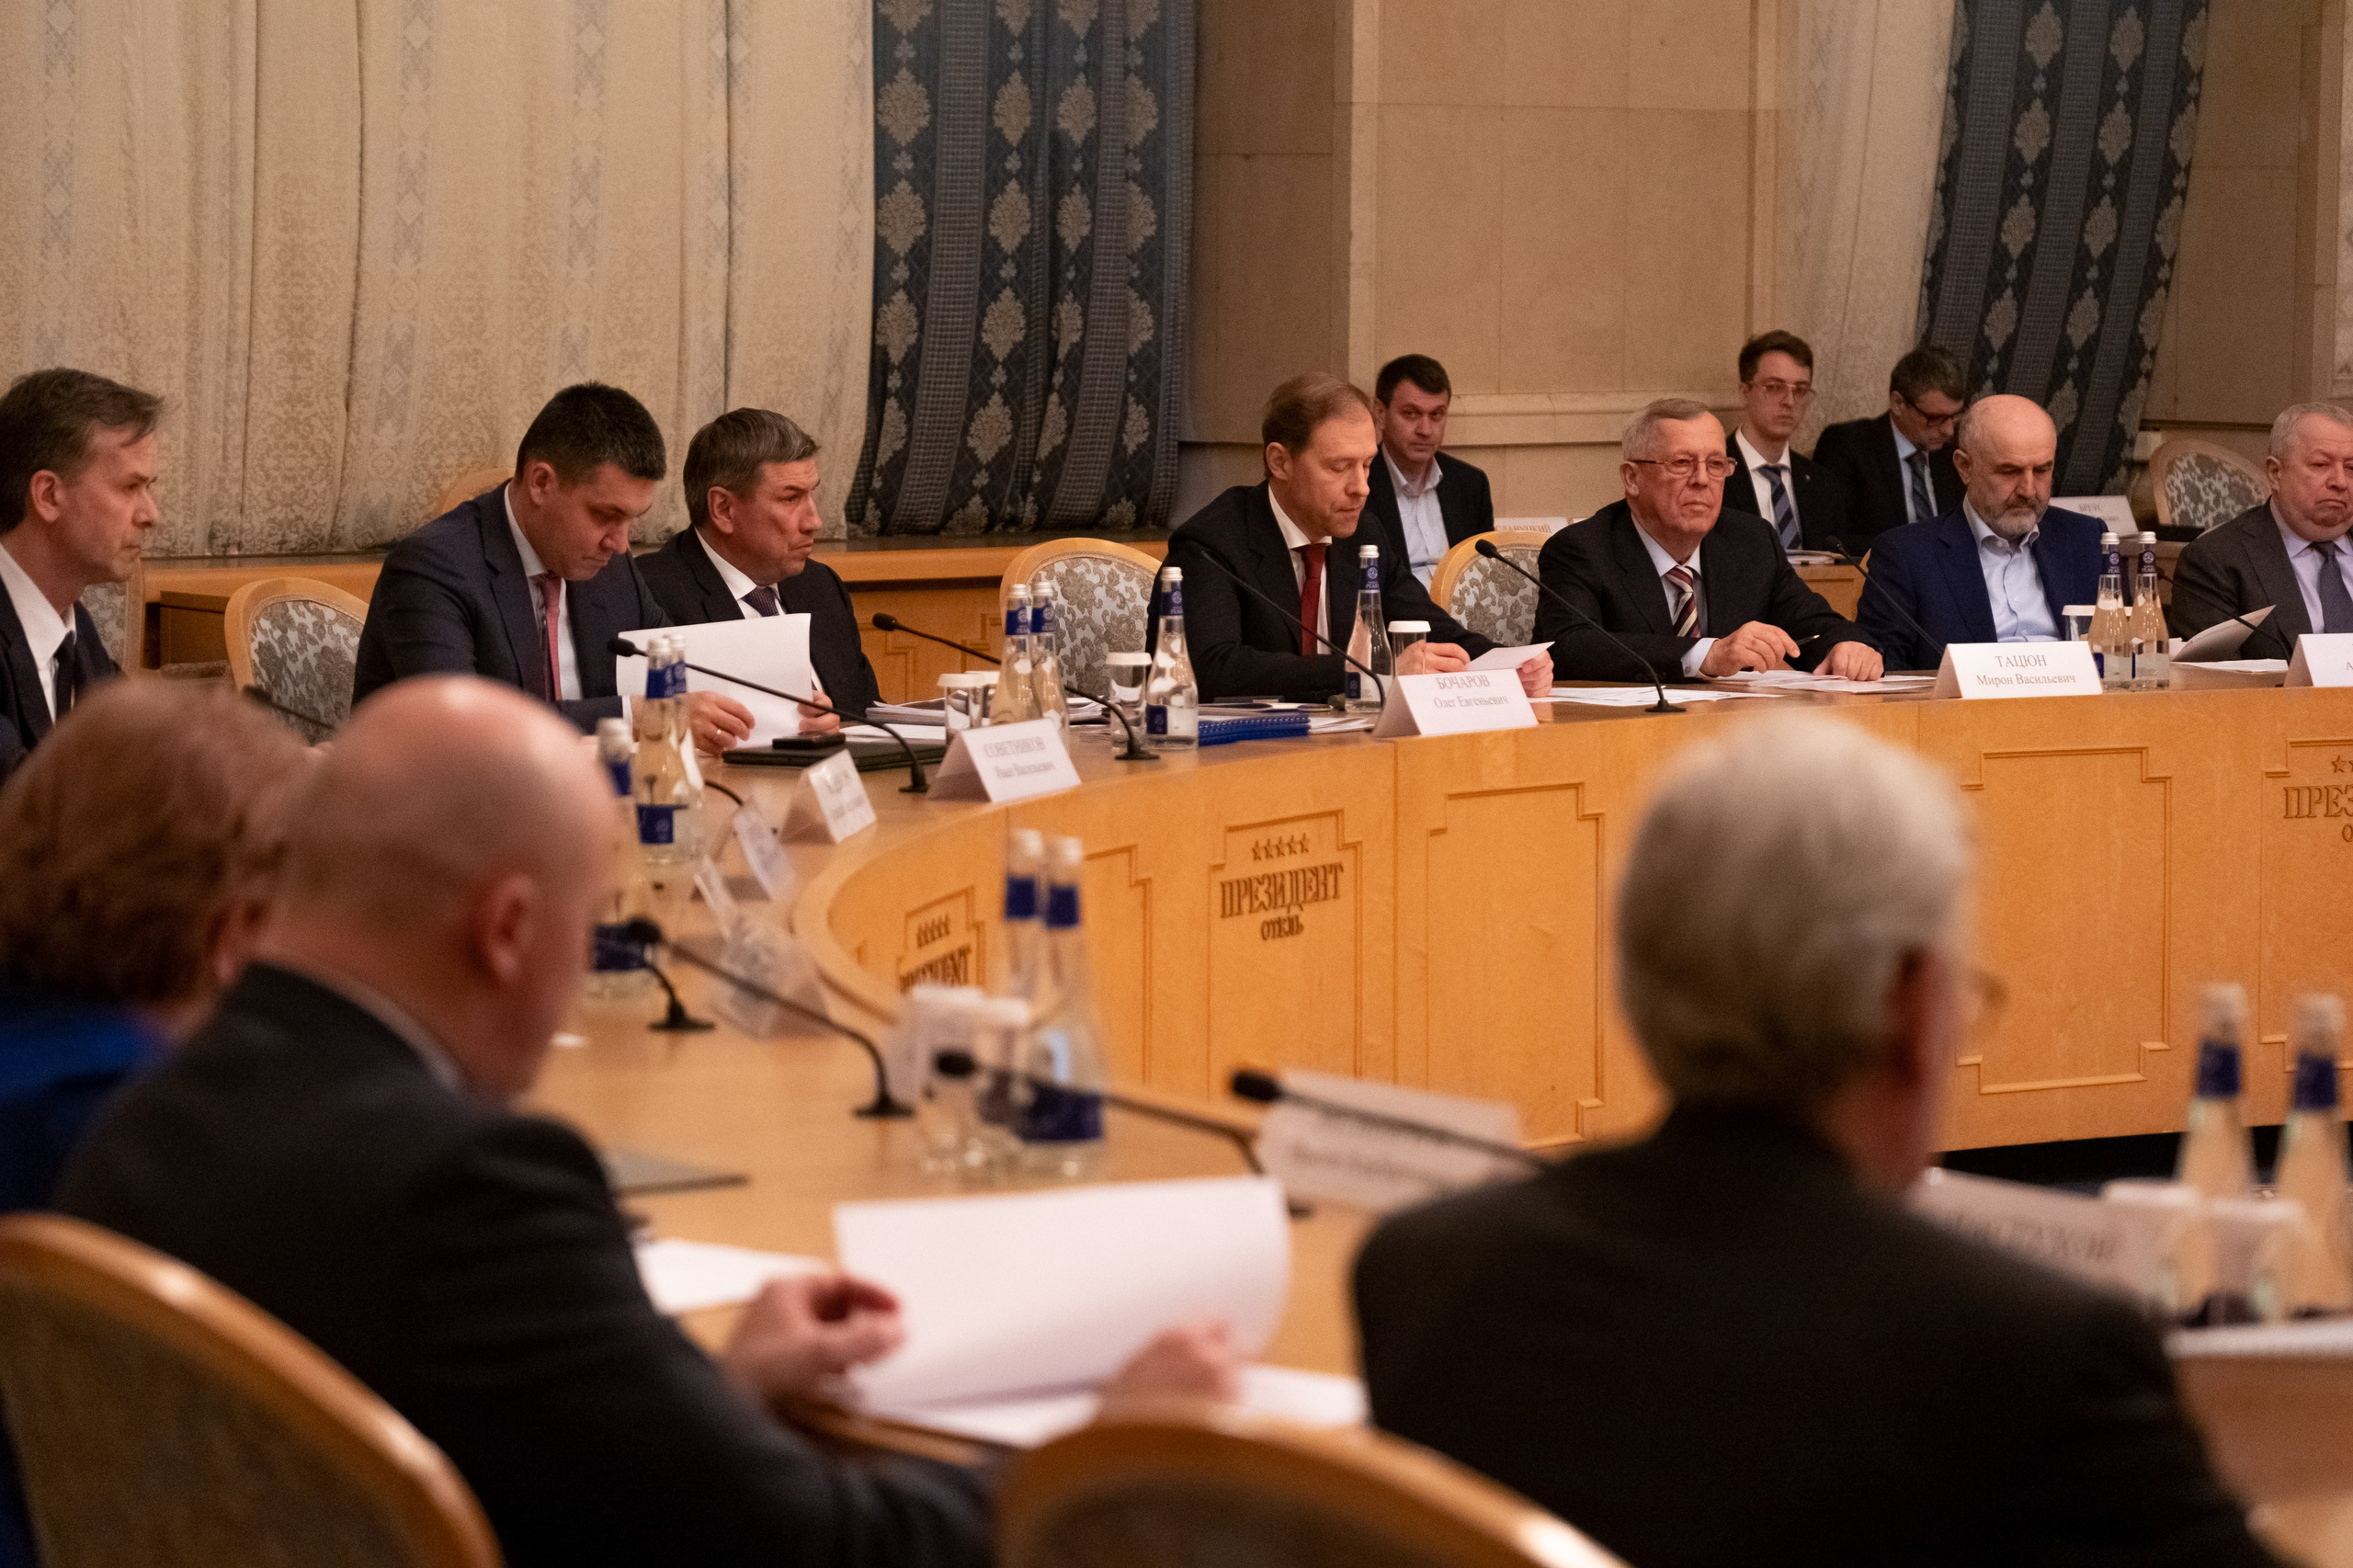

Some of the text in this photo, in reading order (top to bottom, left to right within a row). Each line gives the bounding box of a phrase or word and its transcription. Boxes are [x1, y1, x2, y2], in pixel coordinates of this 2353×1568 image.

[1995, 654, 2048, 668] ТАЦЮН
[1435, 675, 1491, 690] БОЧАРОВ
[1976, 673, 2076, 687] Мирон Васильевич
[1433, 695, 1509, 709] Олег Евгеньевич
[1219, 861, 1345, 919] ПРЕЗИДЕНТ
